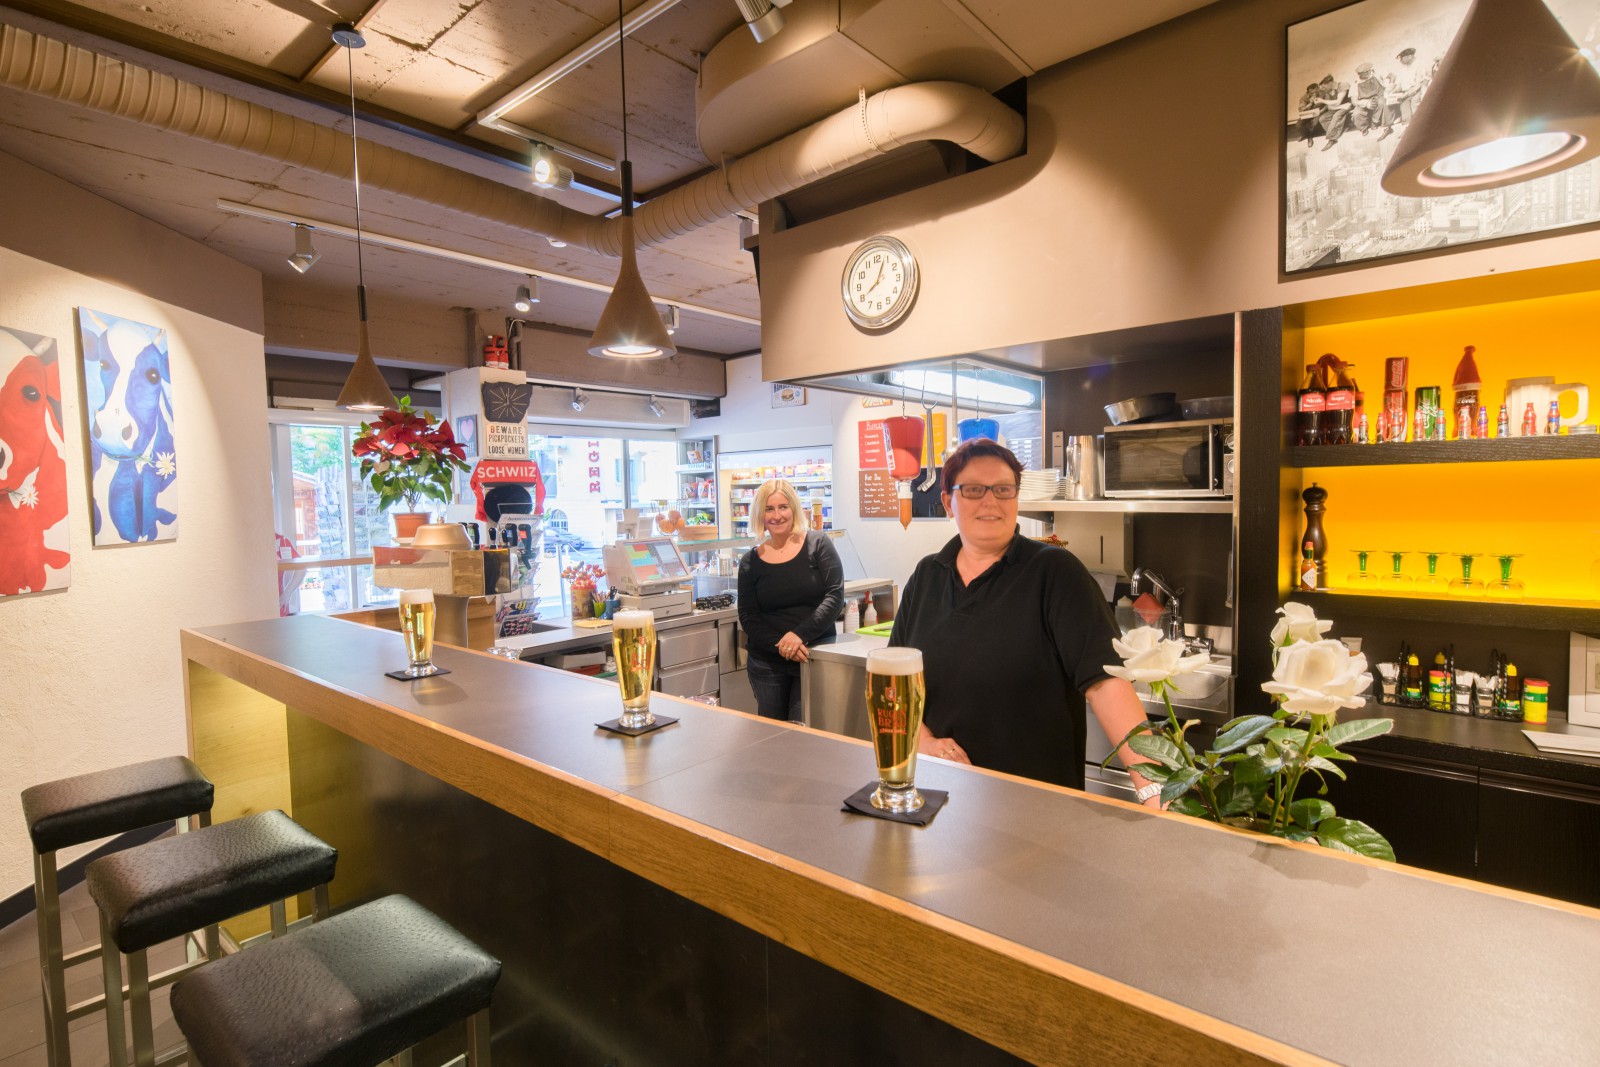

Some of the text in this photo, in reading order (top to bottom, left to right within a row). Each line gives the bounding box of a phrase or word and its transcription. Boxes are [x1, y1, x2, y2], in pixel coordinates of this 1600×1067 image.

[874, 254, 881, 264] 12
[865, 261, 871, 269] 11
[892, 263, 898, 271] 2
[858, 271, 866, 280] 10
[896, 274, 901, 282] 3
[857, 283, 861, 291] 9
[892, 286, 898, 294] 4
[860, 294, 865, 303] 8
[885, 297, 891, 305] 5
[868, 301, 873, 309] 7
[490, 425, 522, 435] BEWARE
[488, 434, 525, 444] PICKPOCKETS
[488, 446, 525, 455] LOOSE WOMEN
[477, 466, 537, 479] SCHWIIZ
